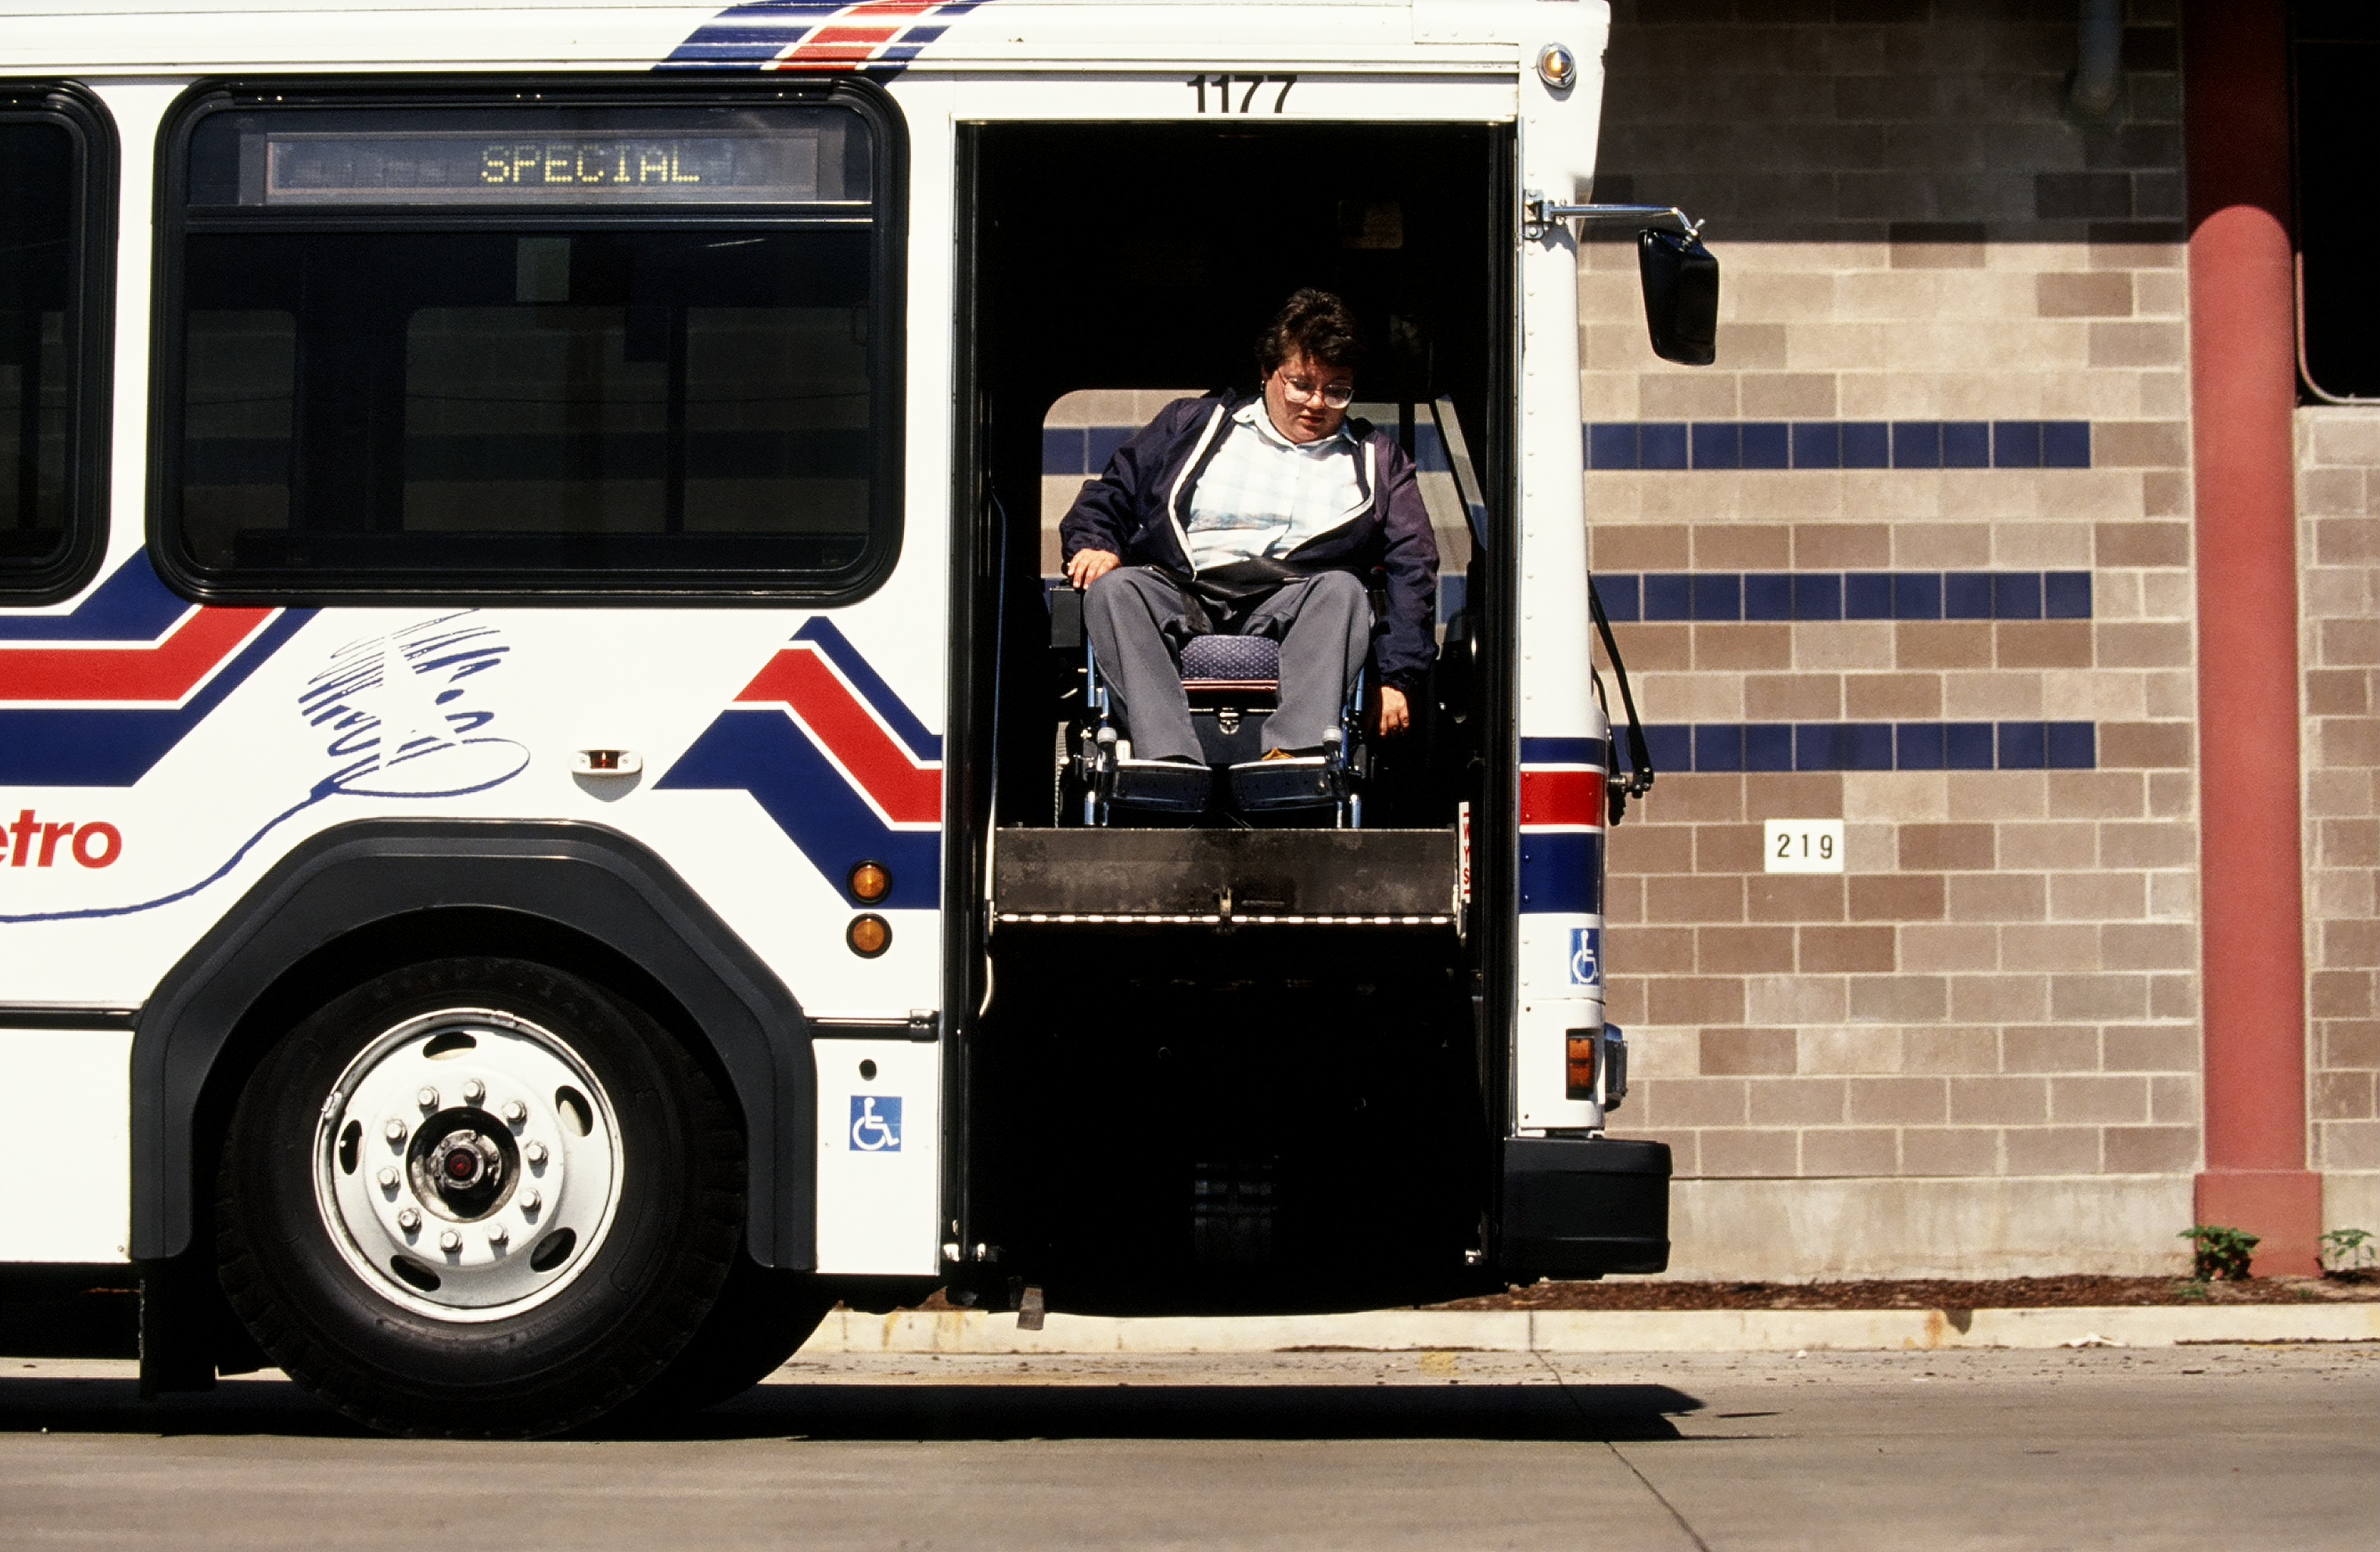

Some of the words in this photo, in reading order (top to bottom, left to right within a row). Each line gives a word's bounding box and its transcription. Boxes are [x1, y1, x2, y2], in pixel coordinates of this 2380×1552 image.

[1187, 74, 1298, 114] 1177
[480, 145, 700, 183] SPECIAL
[0, 809, 123, 869] tro
[1777, 833, 1834, 859] 219
